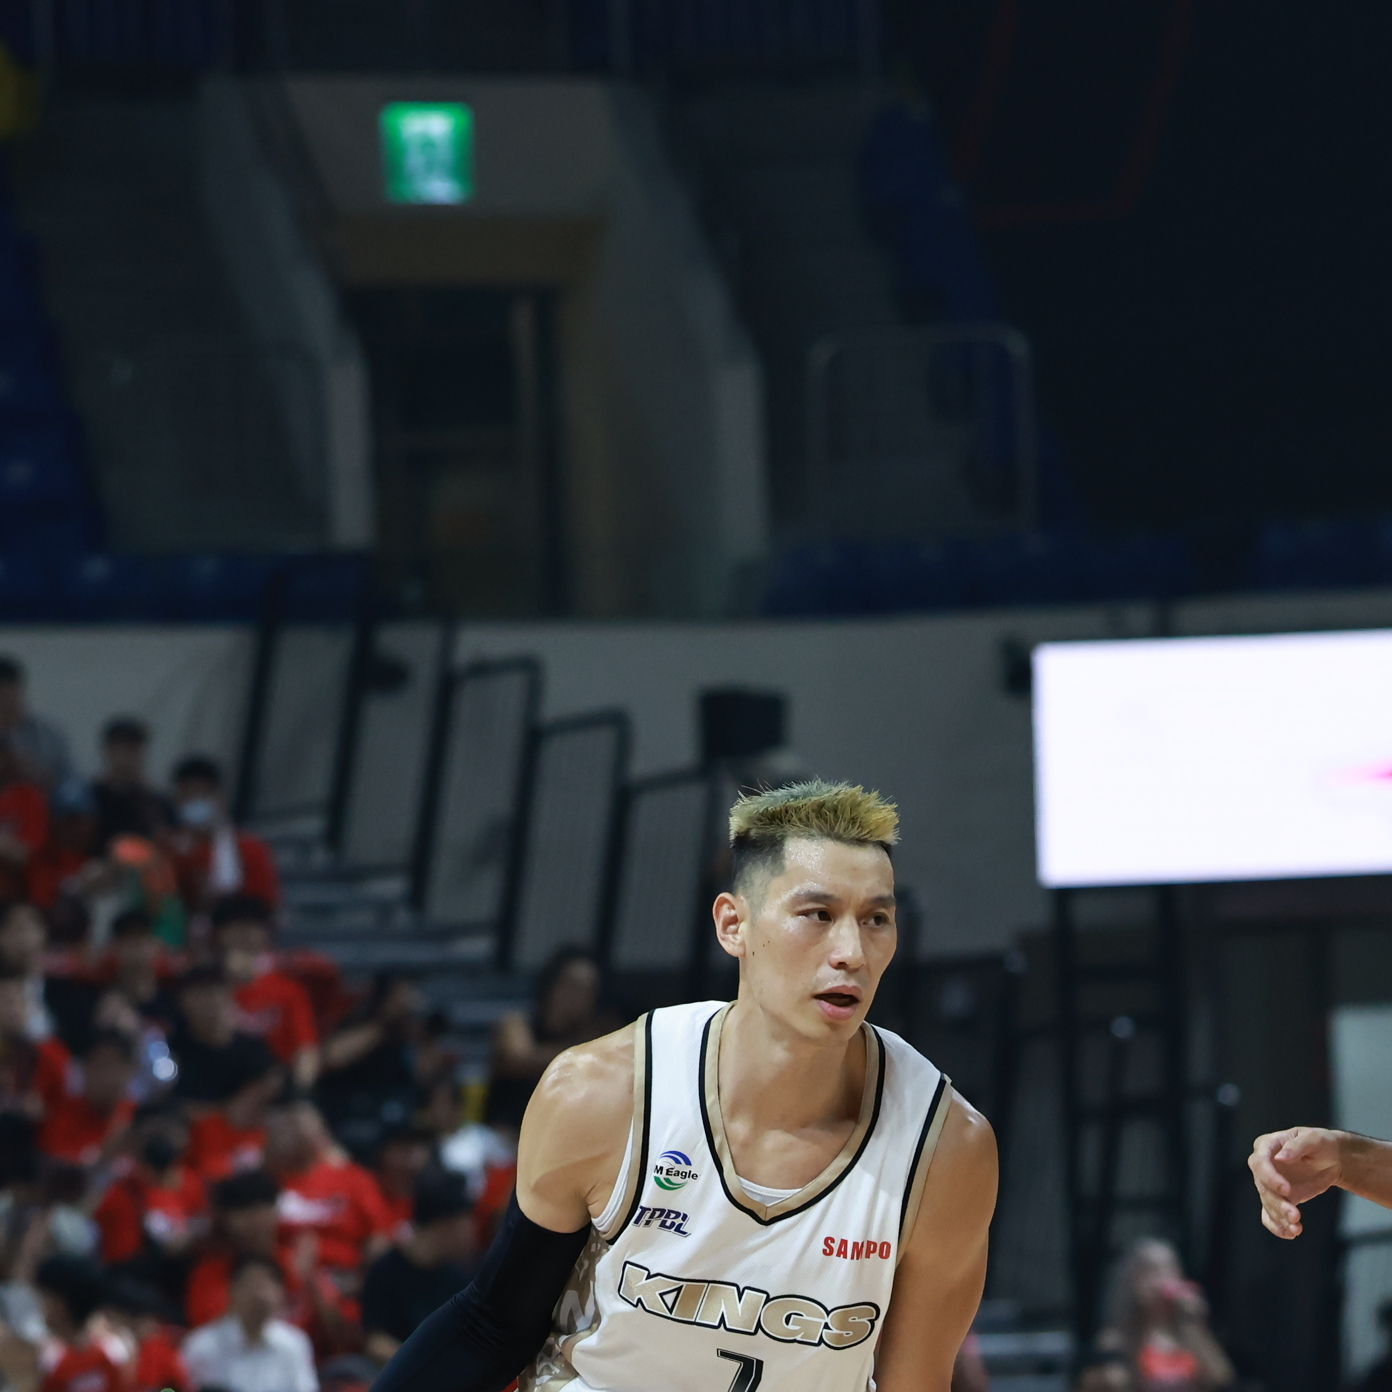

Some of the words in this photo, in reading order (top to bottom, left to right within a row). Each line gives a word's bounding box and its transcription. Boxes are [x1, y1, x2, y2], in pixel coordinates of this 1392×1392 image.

[666, 1167, 698, 1180] Eagle
[633, 1205, 691, 1238] TPBL
[618, 1261, 880, 1350] KINGS
